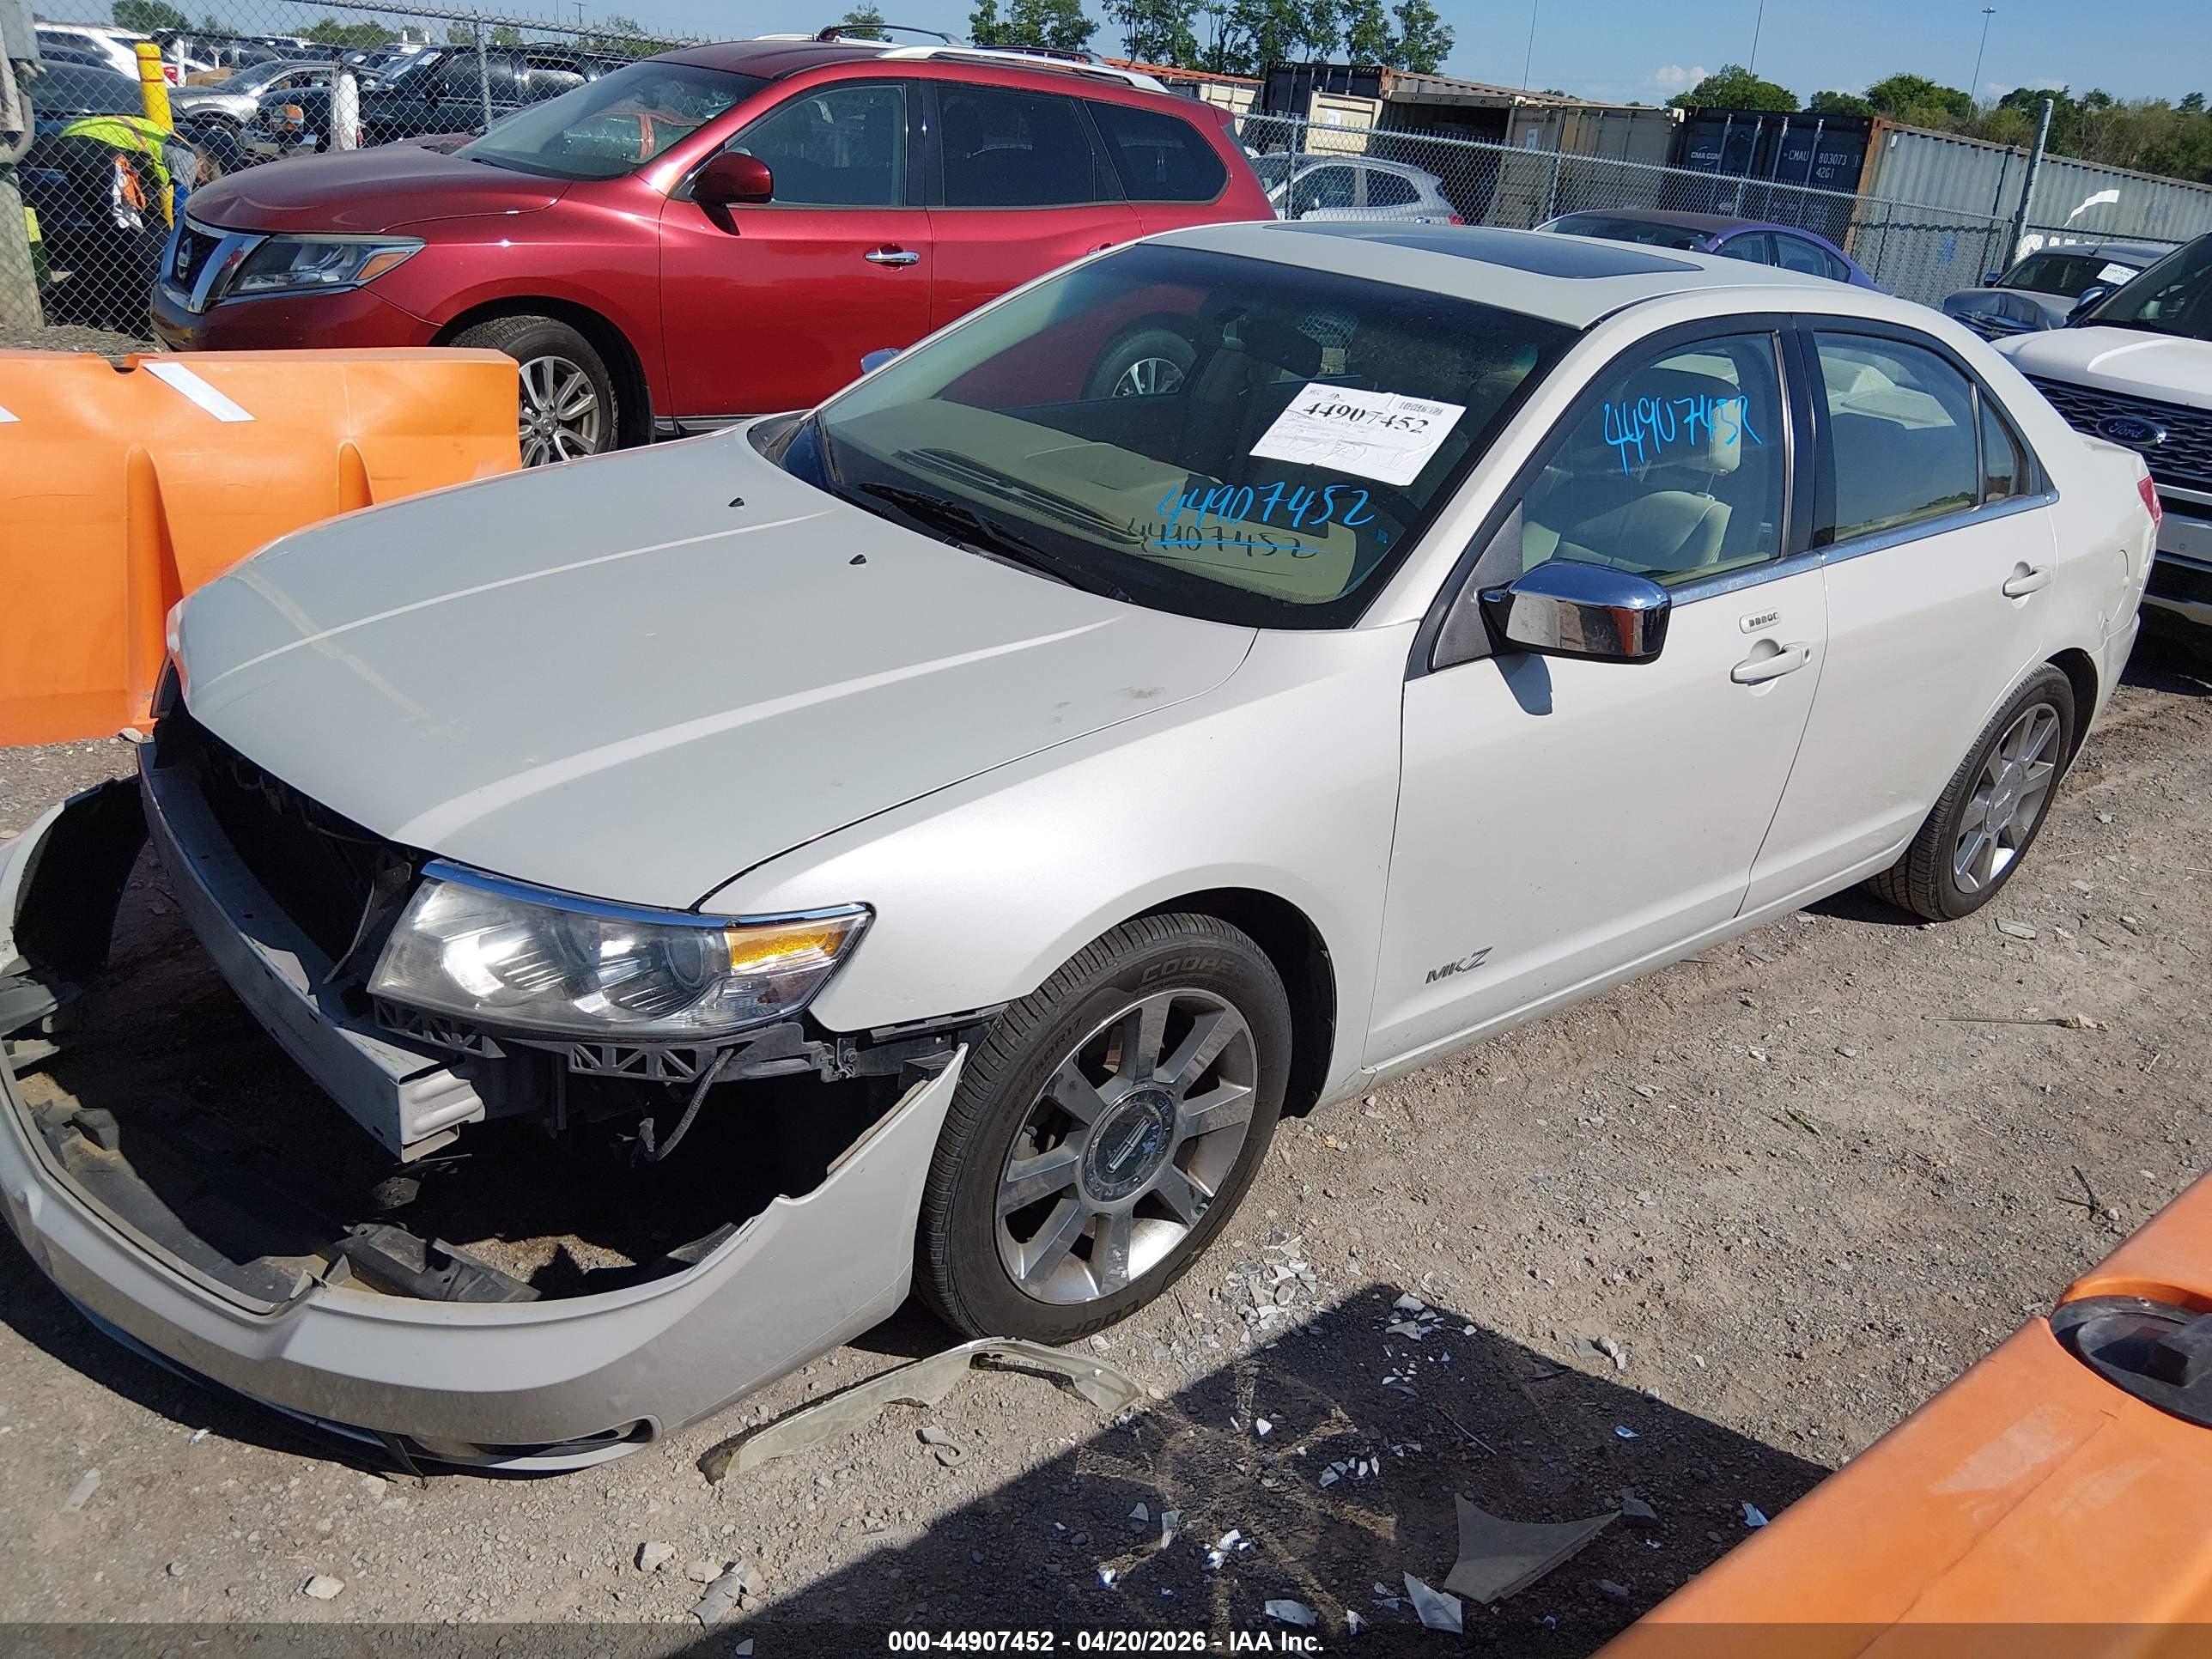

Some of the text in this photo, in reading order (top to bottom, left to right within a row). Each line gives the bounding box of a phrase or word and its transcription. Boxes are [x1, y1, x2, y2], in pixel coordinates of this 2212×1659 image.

[1691, 151, 1705, 160] CMA
[1789, 149, 1810, 161] CMAU
[1818, 152, 1848, 166] 803073
[1815, 167, 1834, 179] 42G1
[1303, 402, 1429, 434] 44907452
[2109, 421, 2146, 438] Ford
[1604, 394, 1763, 476] 44907452
[1157, 481, 1376, 538] 44907452
[1425, 946, 1494, 985] MKZ
